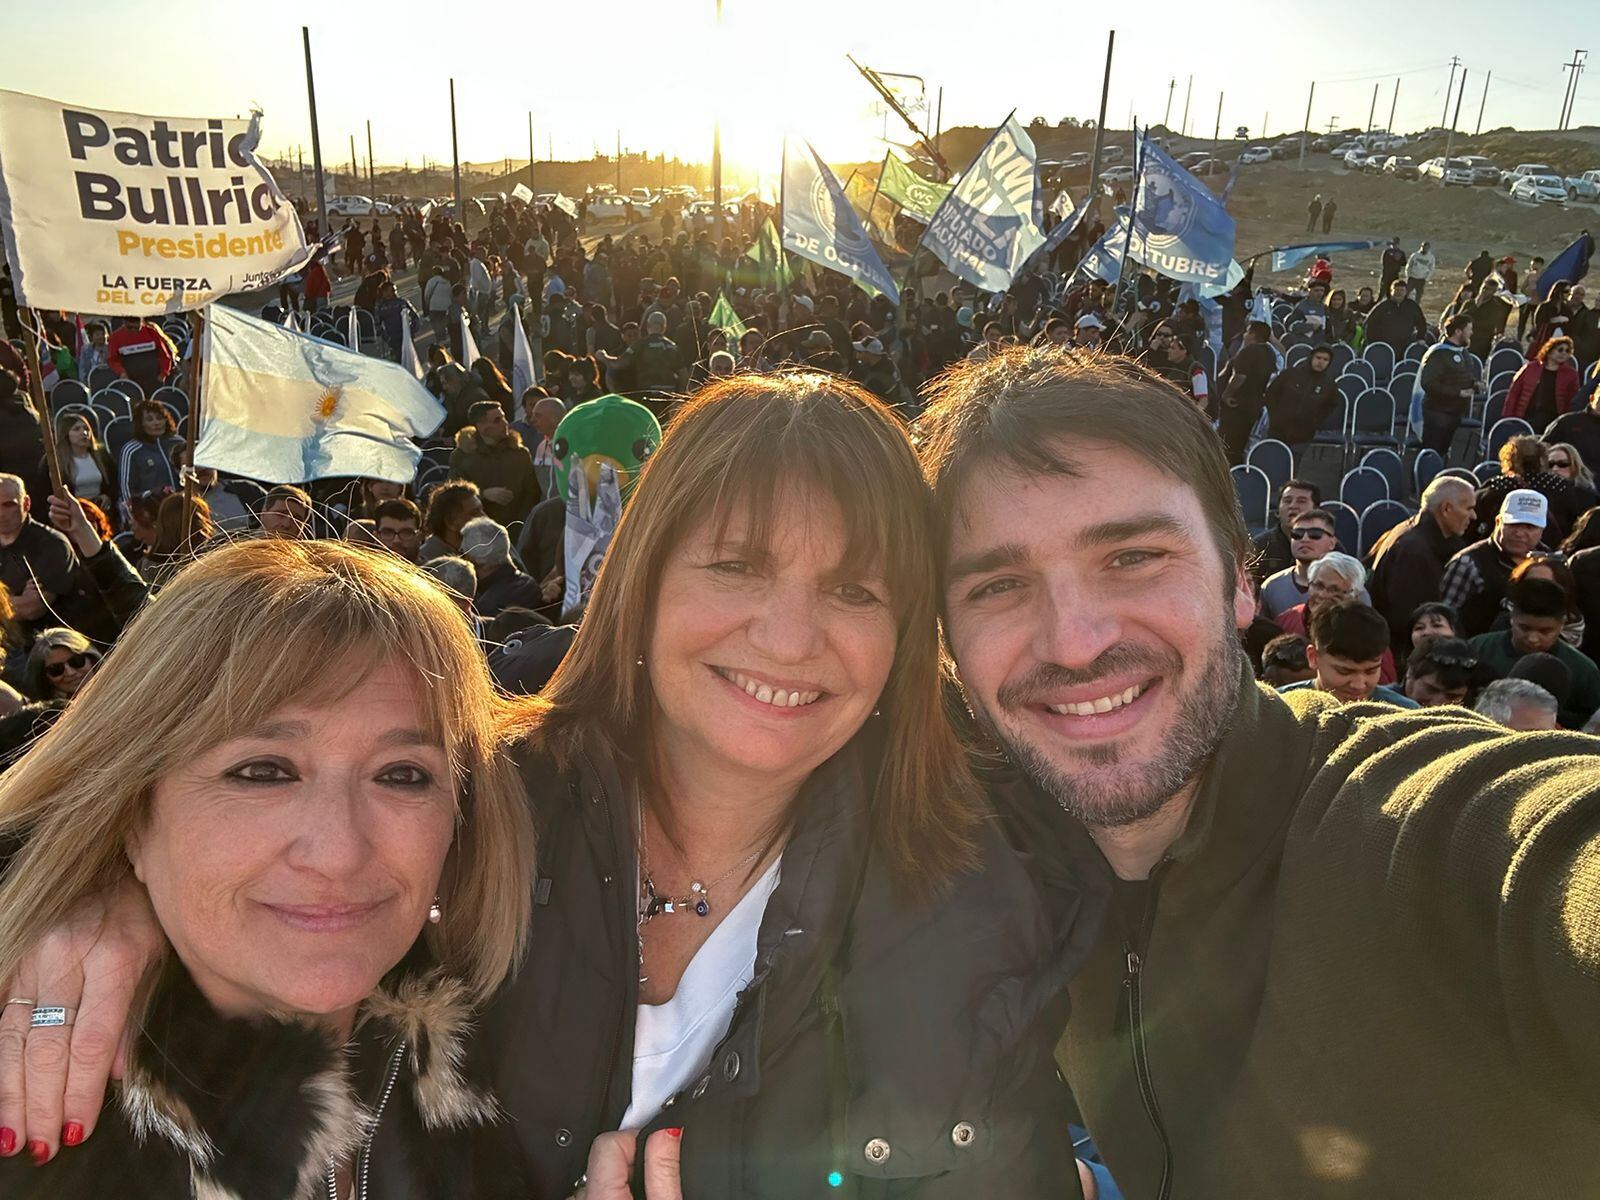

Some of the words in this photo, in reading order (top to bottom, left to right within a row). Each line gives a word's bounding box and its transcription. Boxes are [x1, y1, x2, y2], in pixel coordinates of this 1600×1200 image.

[74, 171, 281, 225] Bullric
[117, 229, 284, 259] Presidente
[795, 232, 820, 255] DE
[1129, 236, 1220, 278] OCTUBRE
[102, 275, 128, 289] LA
[134, 276, 212, 291] FUERZA
[96, 290, 135, 304] DEL
[140, 291, 216, 304] CABIO
